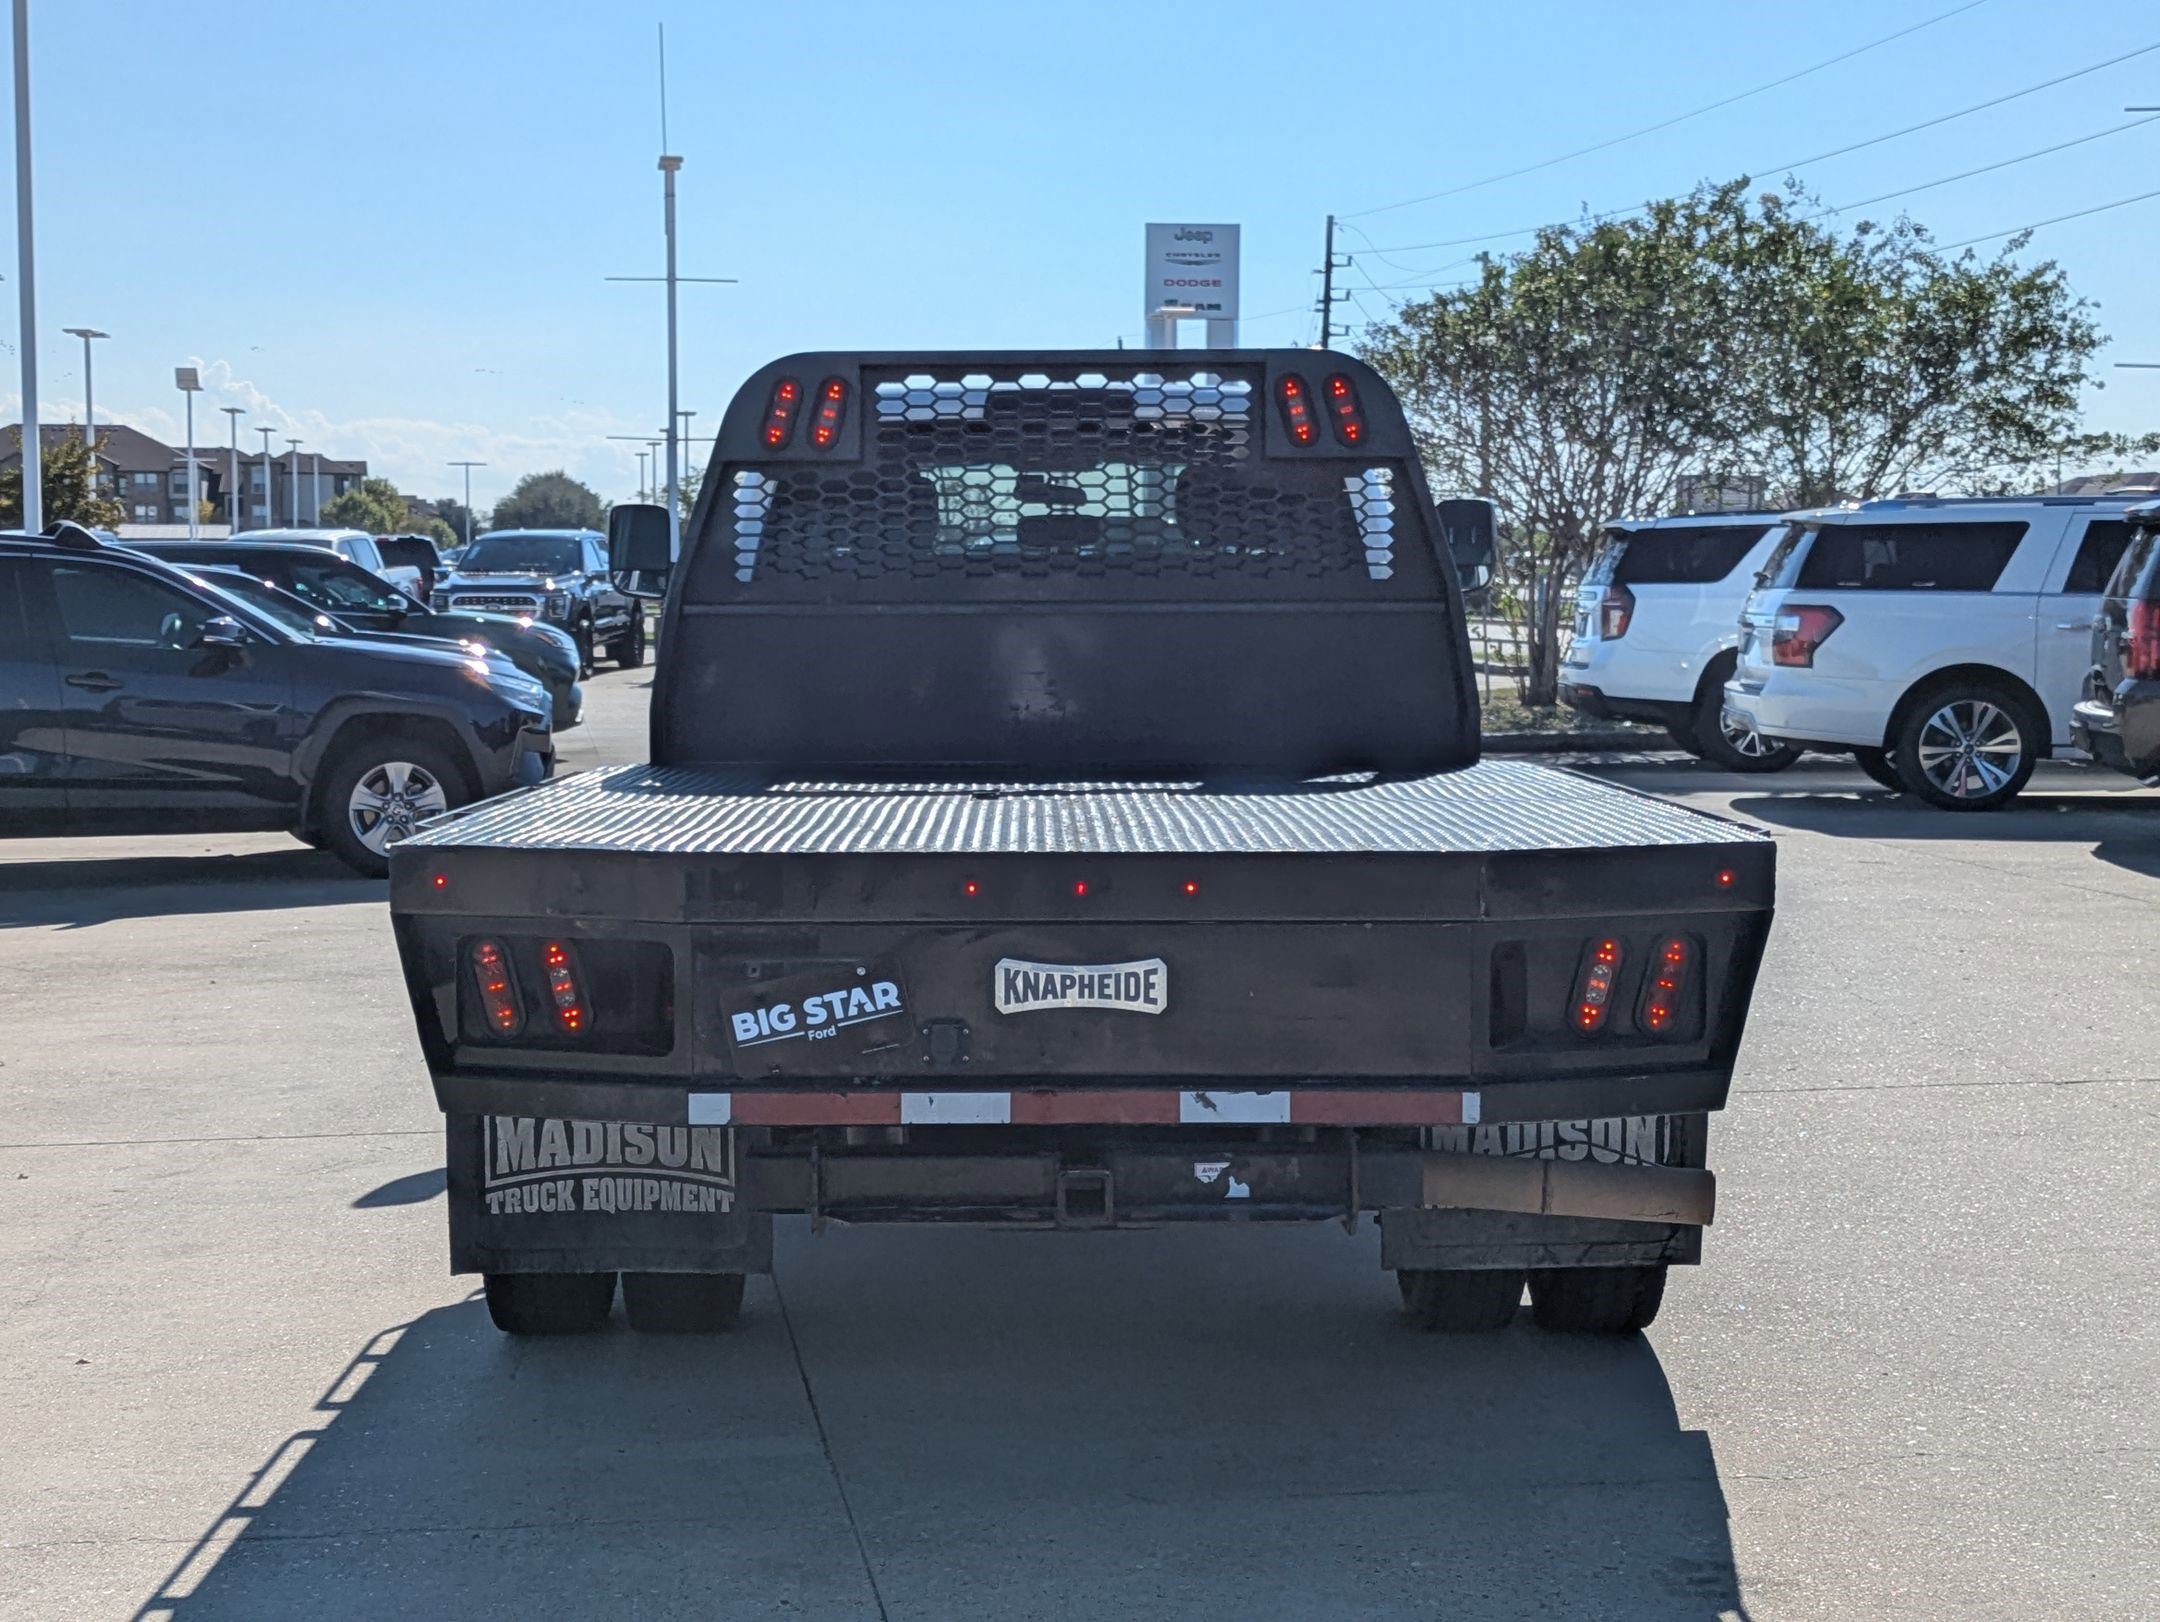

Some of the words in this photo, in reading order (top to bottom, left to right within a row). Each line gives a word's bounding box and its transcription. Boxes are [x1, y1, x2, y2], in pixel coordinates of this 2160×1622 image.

[1174, 227, 1213, 244] Jeep
[1163, 279, 1222, 288] DODGE
[1003, 967, 1159, 1006] KNAPHEIDE
[731, 1003, 797, 1042] BIG
[803, 981, 902, 1026] STAR
[808, 1026, 837, 1041] Ford
[495, 1116, 722, 1174] MADISON
[486, 1180, 576, 1215] TRUCK
[582, 1176, 736, 1214] EQUIPMENT
